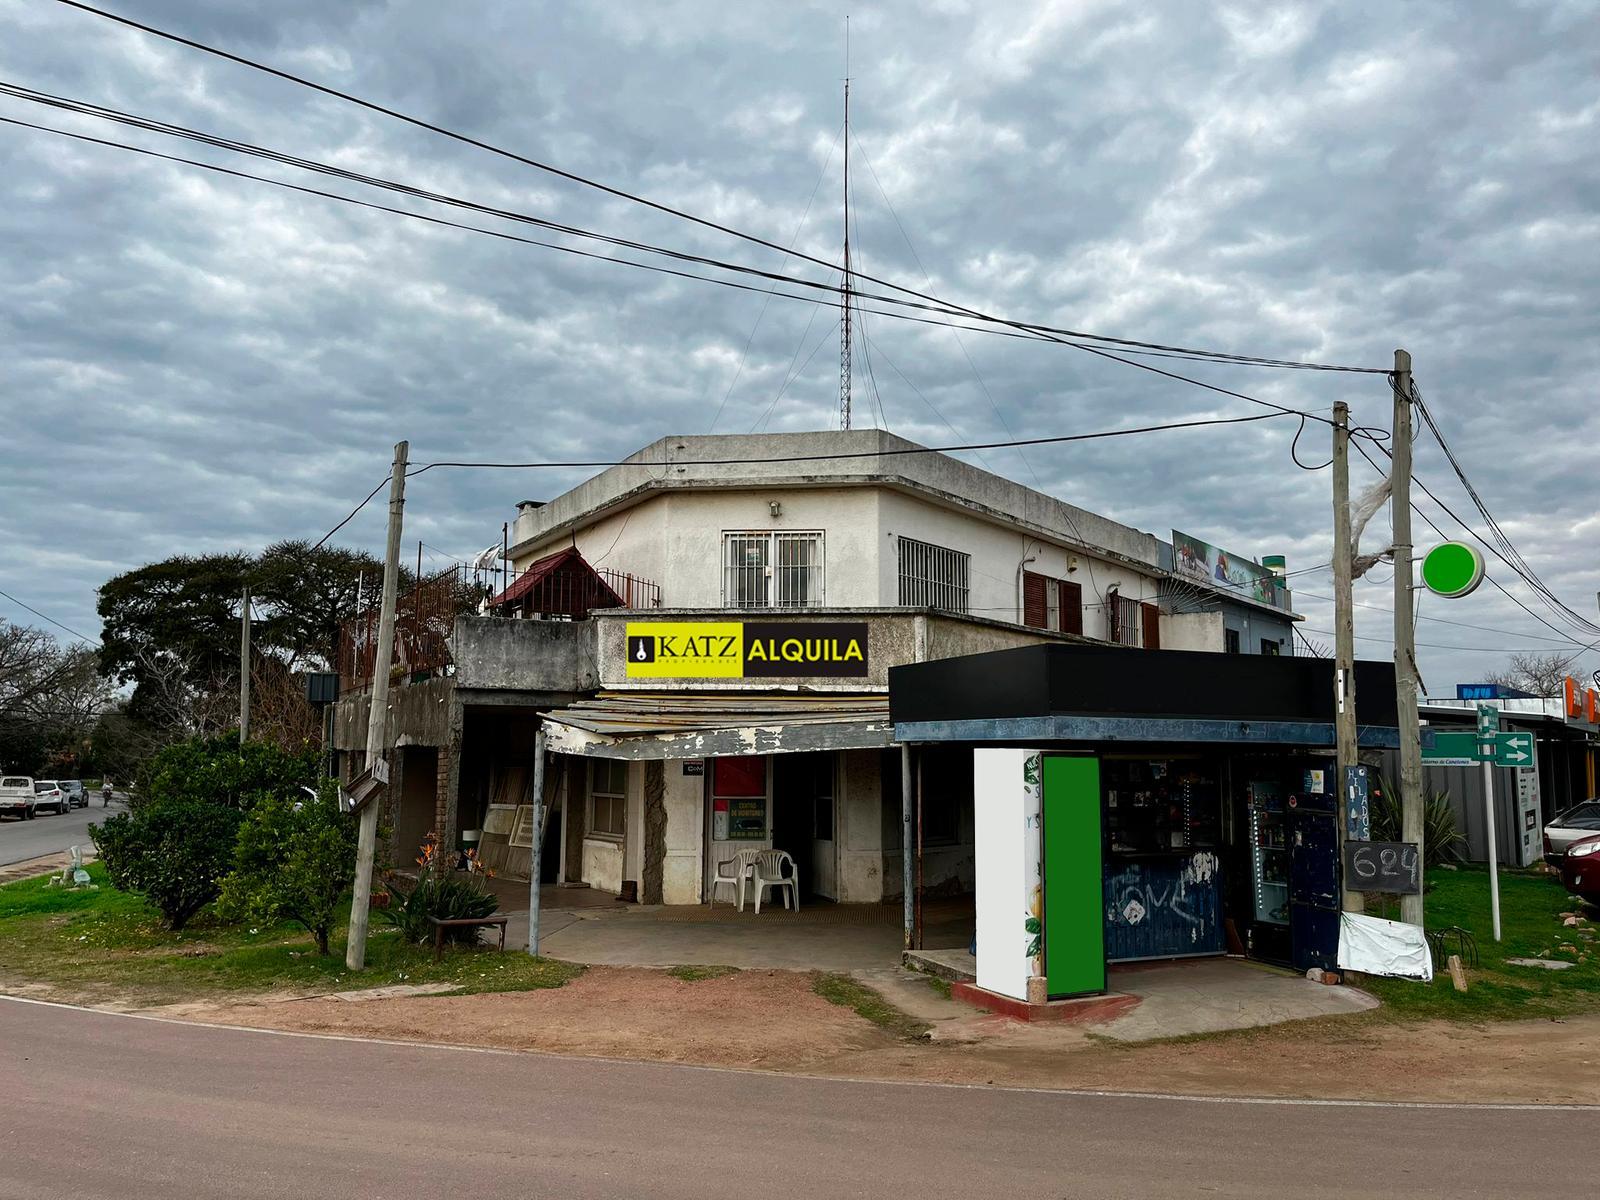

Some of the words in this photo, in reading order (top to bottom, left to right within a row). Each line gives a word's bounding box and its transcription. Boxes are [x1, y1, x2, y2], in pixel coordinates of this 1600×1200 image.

[658, 636, 737, 658] KATZ
[747, 638, 864, 662] ALQUILA
[1353, 847, 1418, 888] 624
